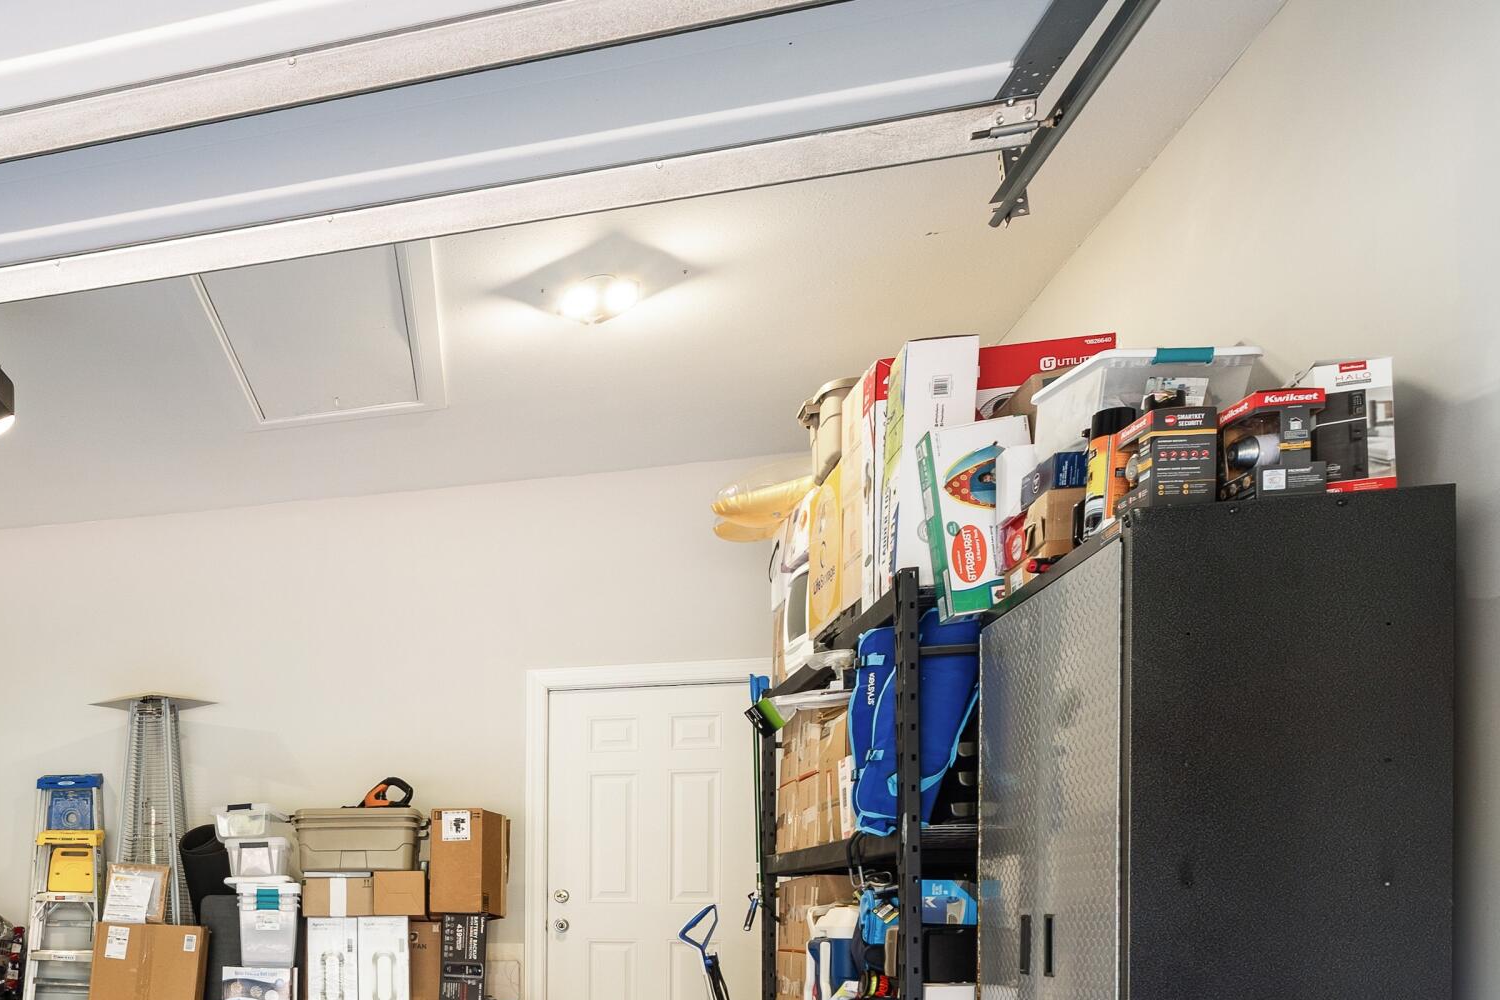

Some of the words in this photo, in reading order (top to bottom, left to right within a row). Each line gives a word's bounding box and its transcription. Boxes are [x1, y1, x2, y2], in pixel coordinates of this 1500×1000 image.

[1335, 371, 1372, 382] HALO
[1264, 392, 1319, 405] Kwikset
[1219, 401, 1249, 425] Kwikset
